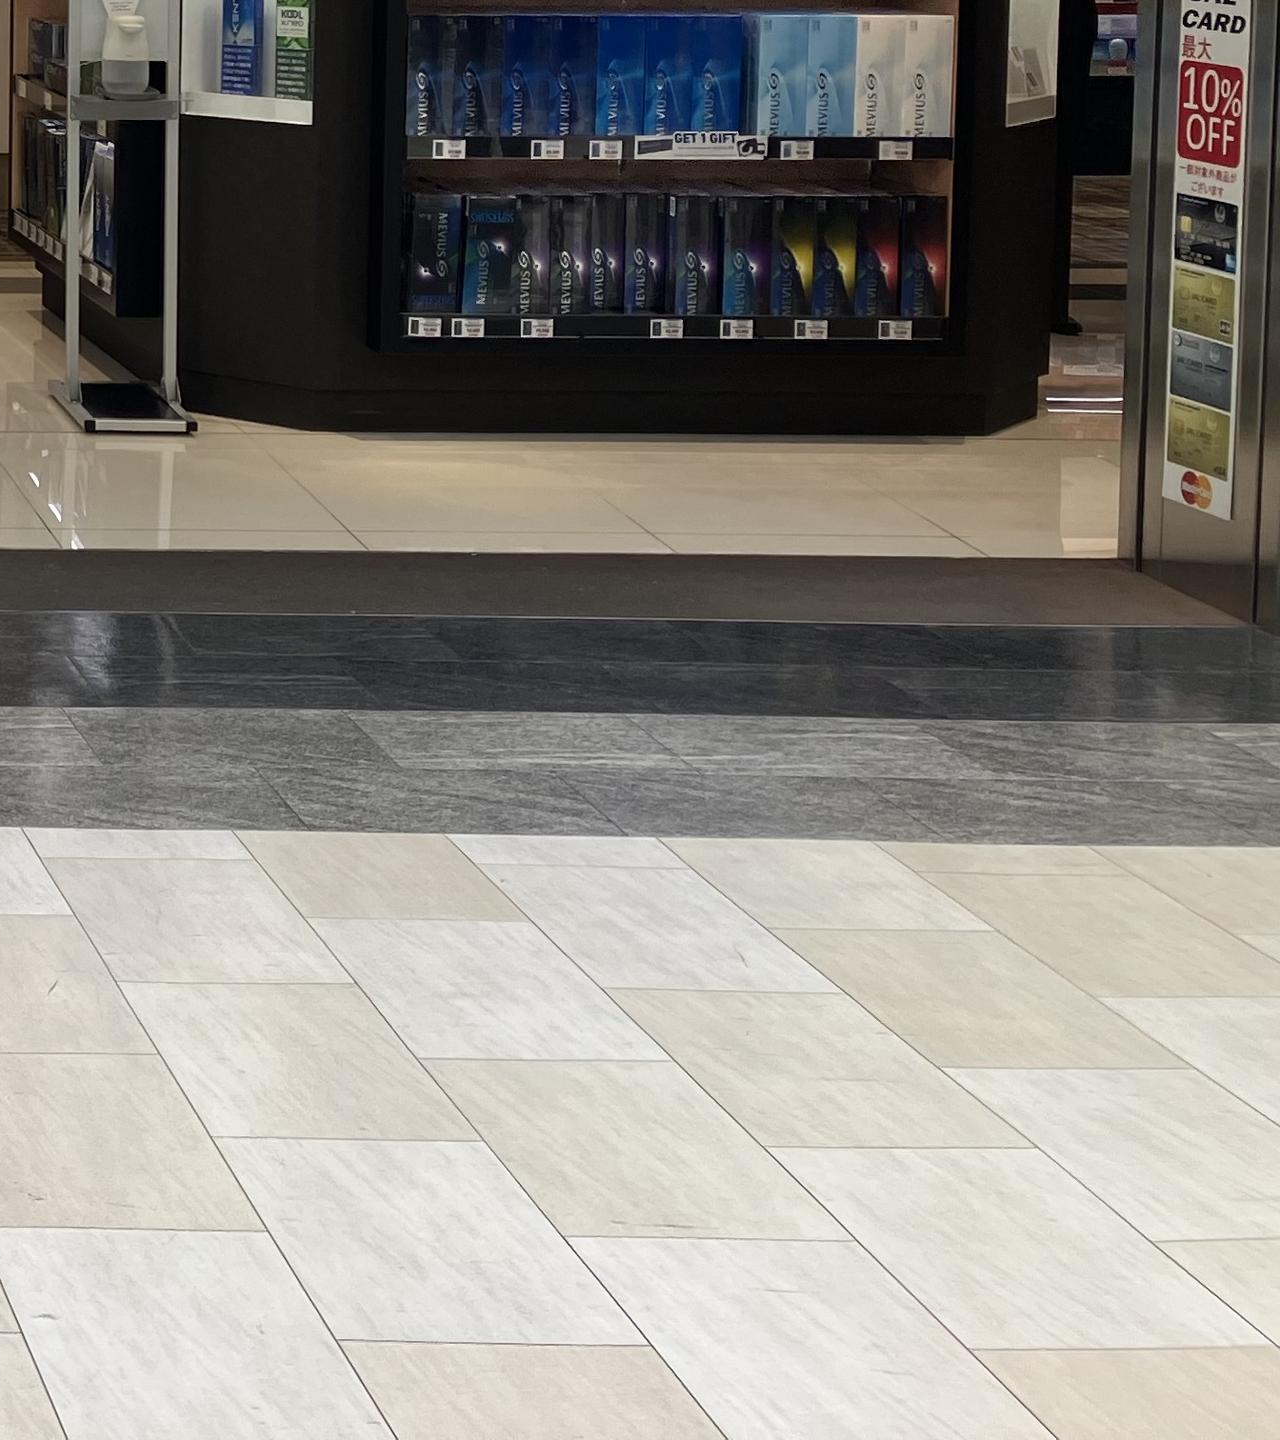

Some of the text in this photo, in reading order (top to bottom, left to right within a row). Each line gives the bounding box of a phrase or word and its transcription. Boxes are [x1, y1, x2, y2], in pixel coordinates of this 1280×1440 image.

[281, 9, 303, 19] KOOL
[1182, 9, 1246, 34] CARD
[1181, 34, 1212, 60] 最大
[417, 91, 429, 137] MEVIUS
[769, 92, 781, 137] MEVIUS
[817, 92, 829, 137] MEVIUS
[864, 92, 877, 137] MEVIUS
[913, 92, 926, 137] MEVIUS
[1183, 66, 1243, 118] 10%
[674, 133, 736, 144] GET 1 GIFT
[1185, 113, 1236, 156] OFF
[1191, 180, 1225, 199] ございます
[435, 212, 449, 258] MEVIUS
[475, 261, 489, 305] MEVIUS
[519, 269, 531, 314] MEVIUS
[560, 269, 572, 314] MEVIUS
[686, 270, 698, 316] MEVIUS
